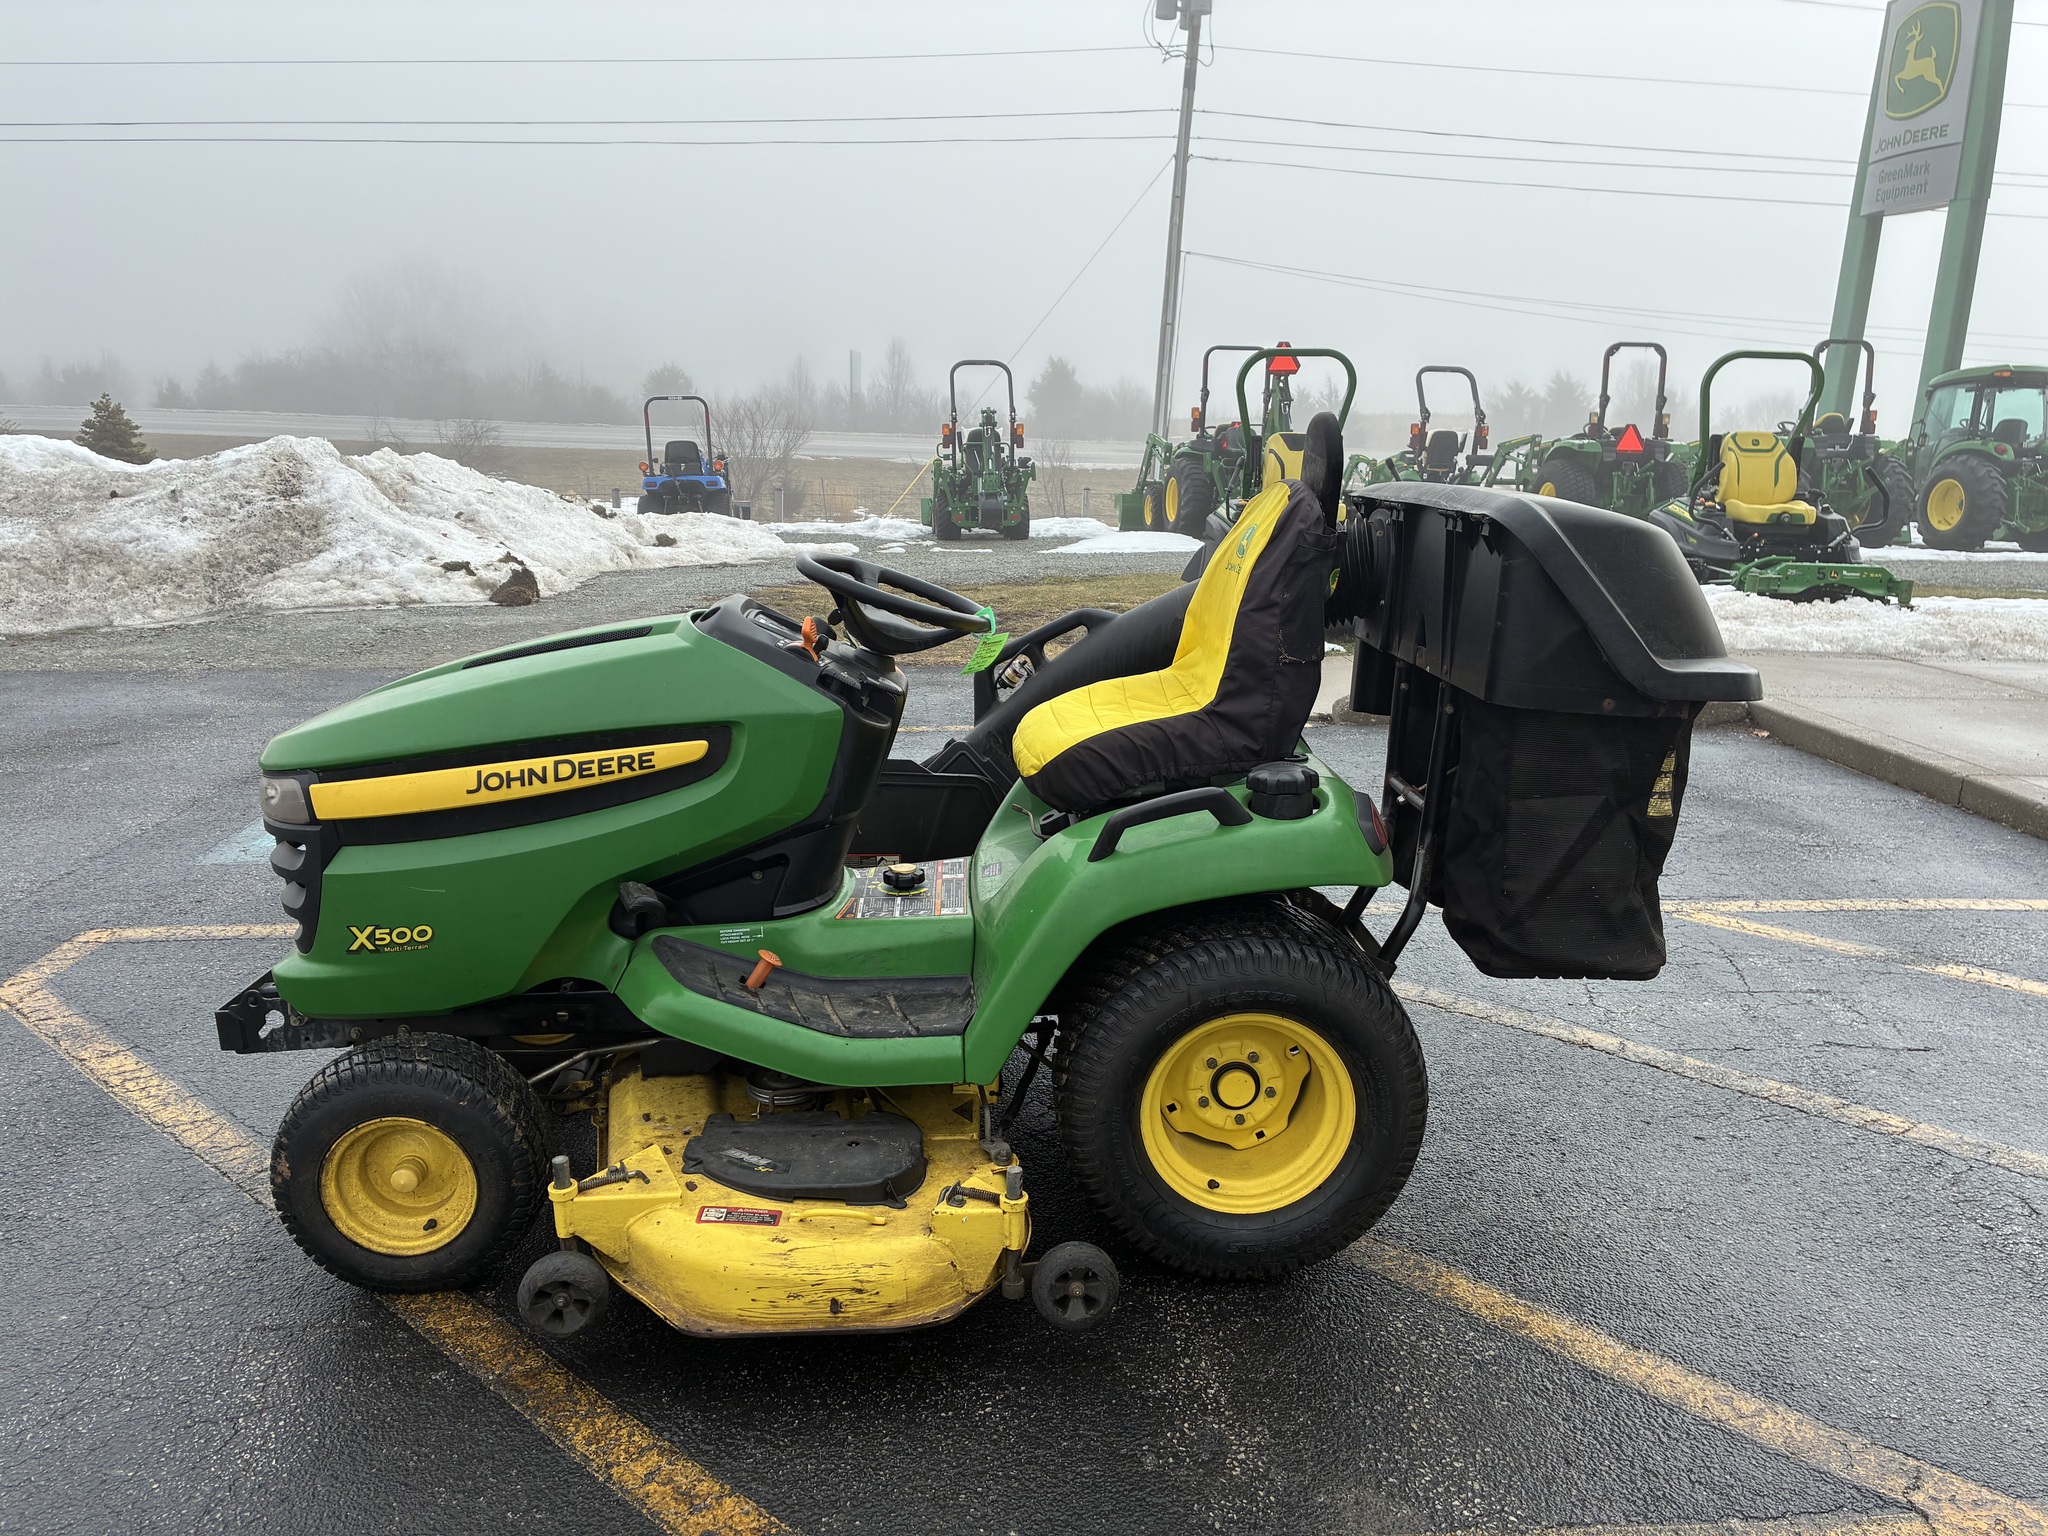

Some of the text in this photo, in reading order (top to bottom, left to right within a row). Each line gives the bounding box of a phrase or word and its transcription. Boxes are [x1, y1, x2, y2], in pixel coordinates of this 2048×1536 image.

[1875, 123, 1949, 155] JOHN DEERE
[1879, 160, 1931, 184] GreenMark
[1876, 179, 1928, 204] Equipment
[466, 751, 656, 794] JOHN DEERE
[348, 925, 433, 951] X500
